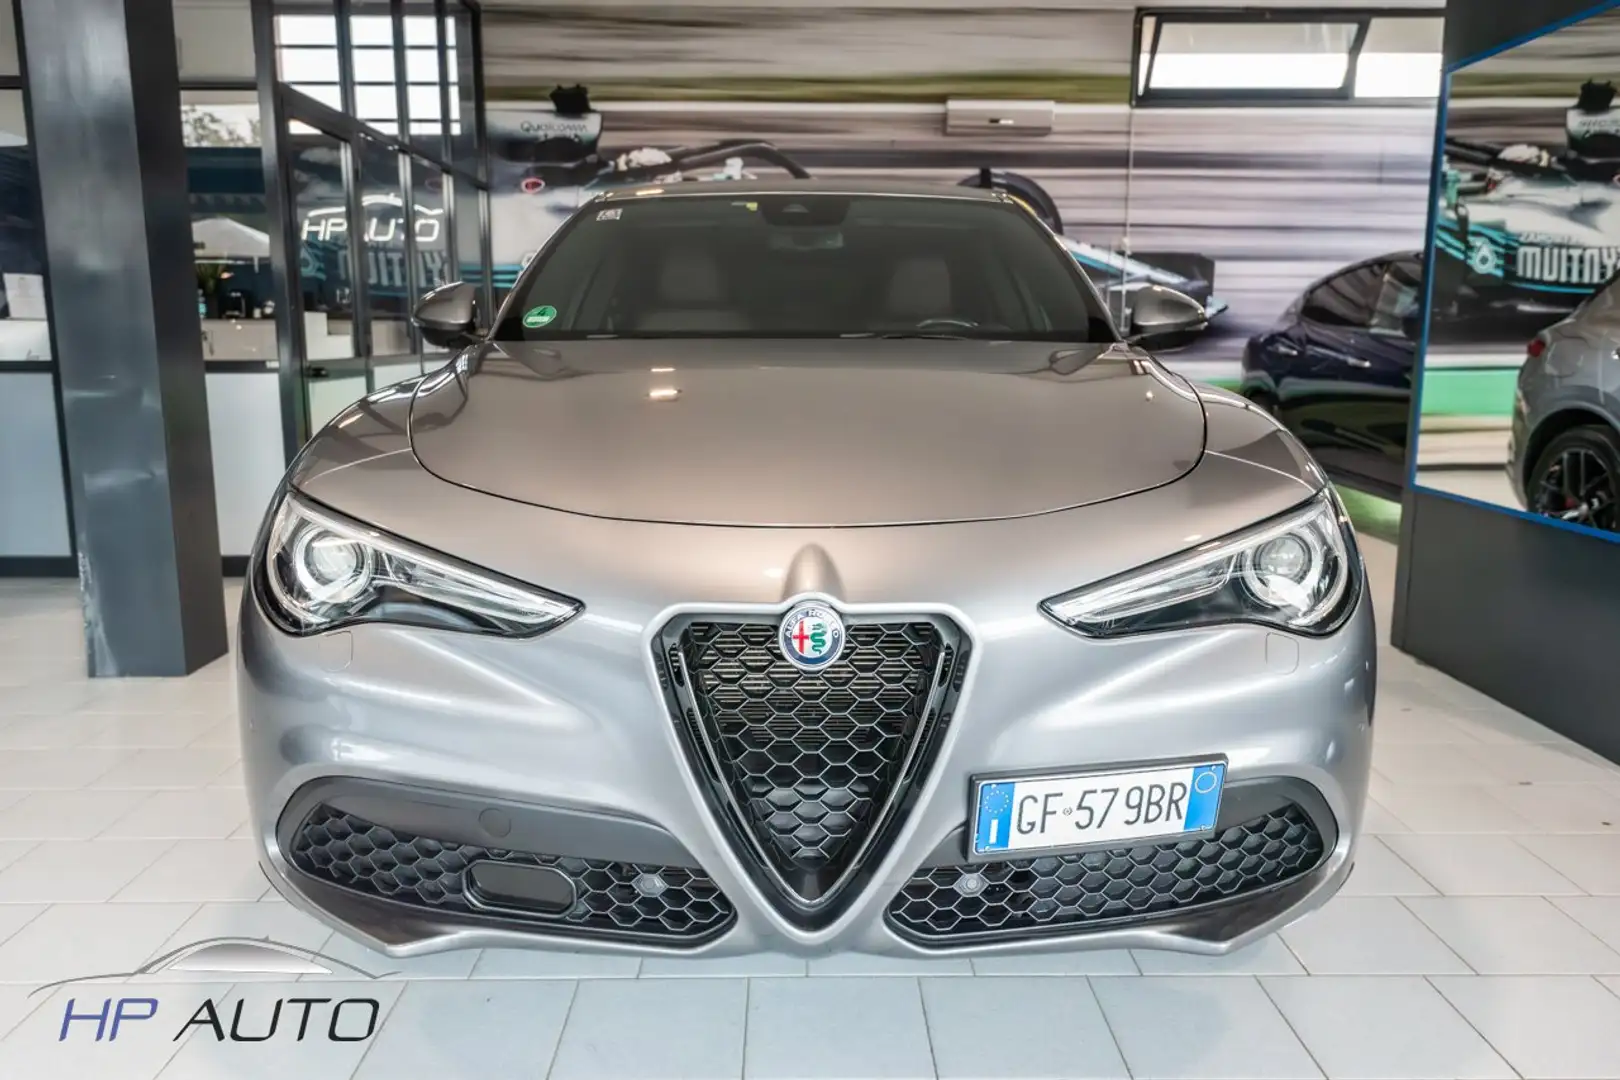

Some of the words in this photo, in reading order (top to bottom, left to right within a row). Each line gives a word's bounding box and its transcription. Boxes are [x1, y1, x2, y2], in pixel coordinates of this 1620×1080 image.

[301, 218, 348, 241] HP
[363, 217, 440, 243] UO
[785, 613, 804, 638] ALFA
[808, 609, 840, 639] ROEO
[1016, 792, 1063, 835] GF
[1074, 782, 1187, 830] 579BR
